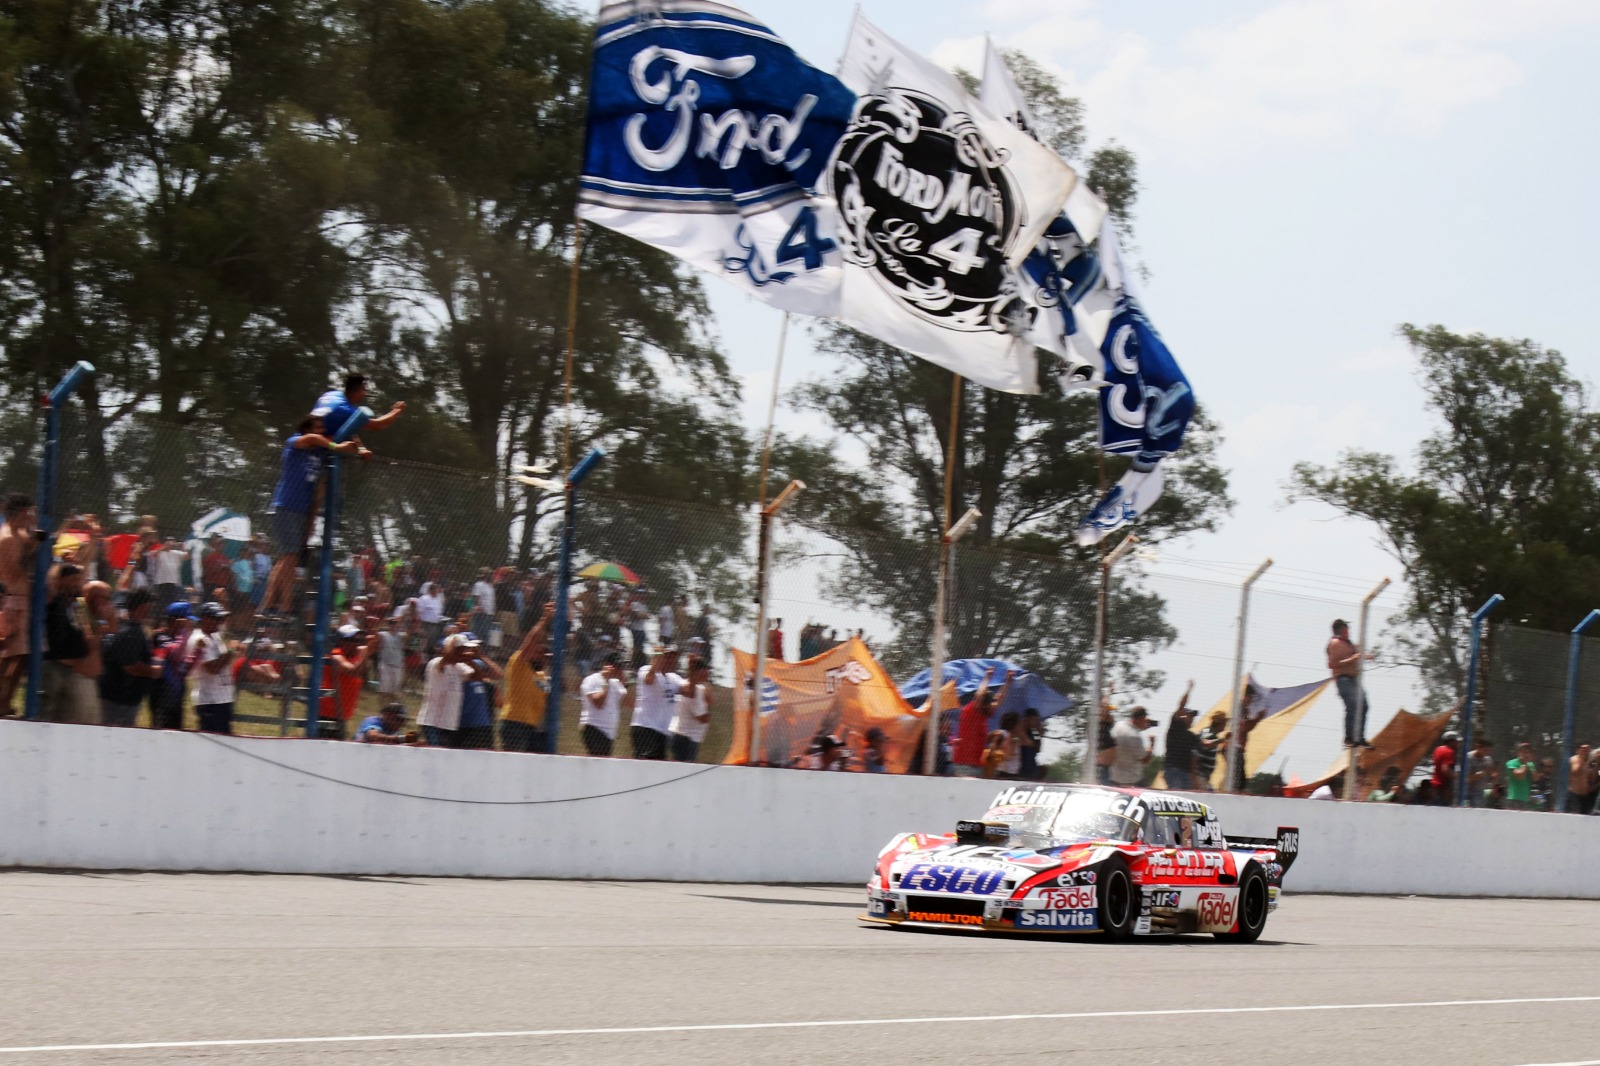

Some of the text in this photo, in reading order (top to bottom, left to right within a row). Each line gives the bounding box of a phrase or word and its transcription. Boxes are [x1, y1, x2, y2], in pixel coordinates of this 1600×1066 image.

[927, 227, 986, 276] 4
[988, 785, 1146, 824] Haimch
[899, 863, 1007, 896] ESCO
[1038, 886, 1094, 910] Fadel
[1197, 892, 1238, 926] Fadel
[909, 911, 984, 925] HAMILTON
[1021, 910, 1094, 926] Salvita
